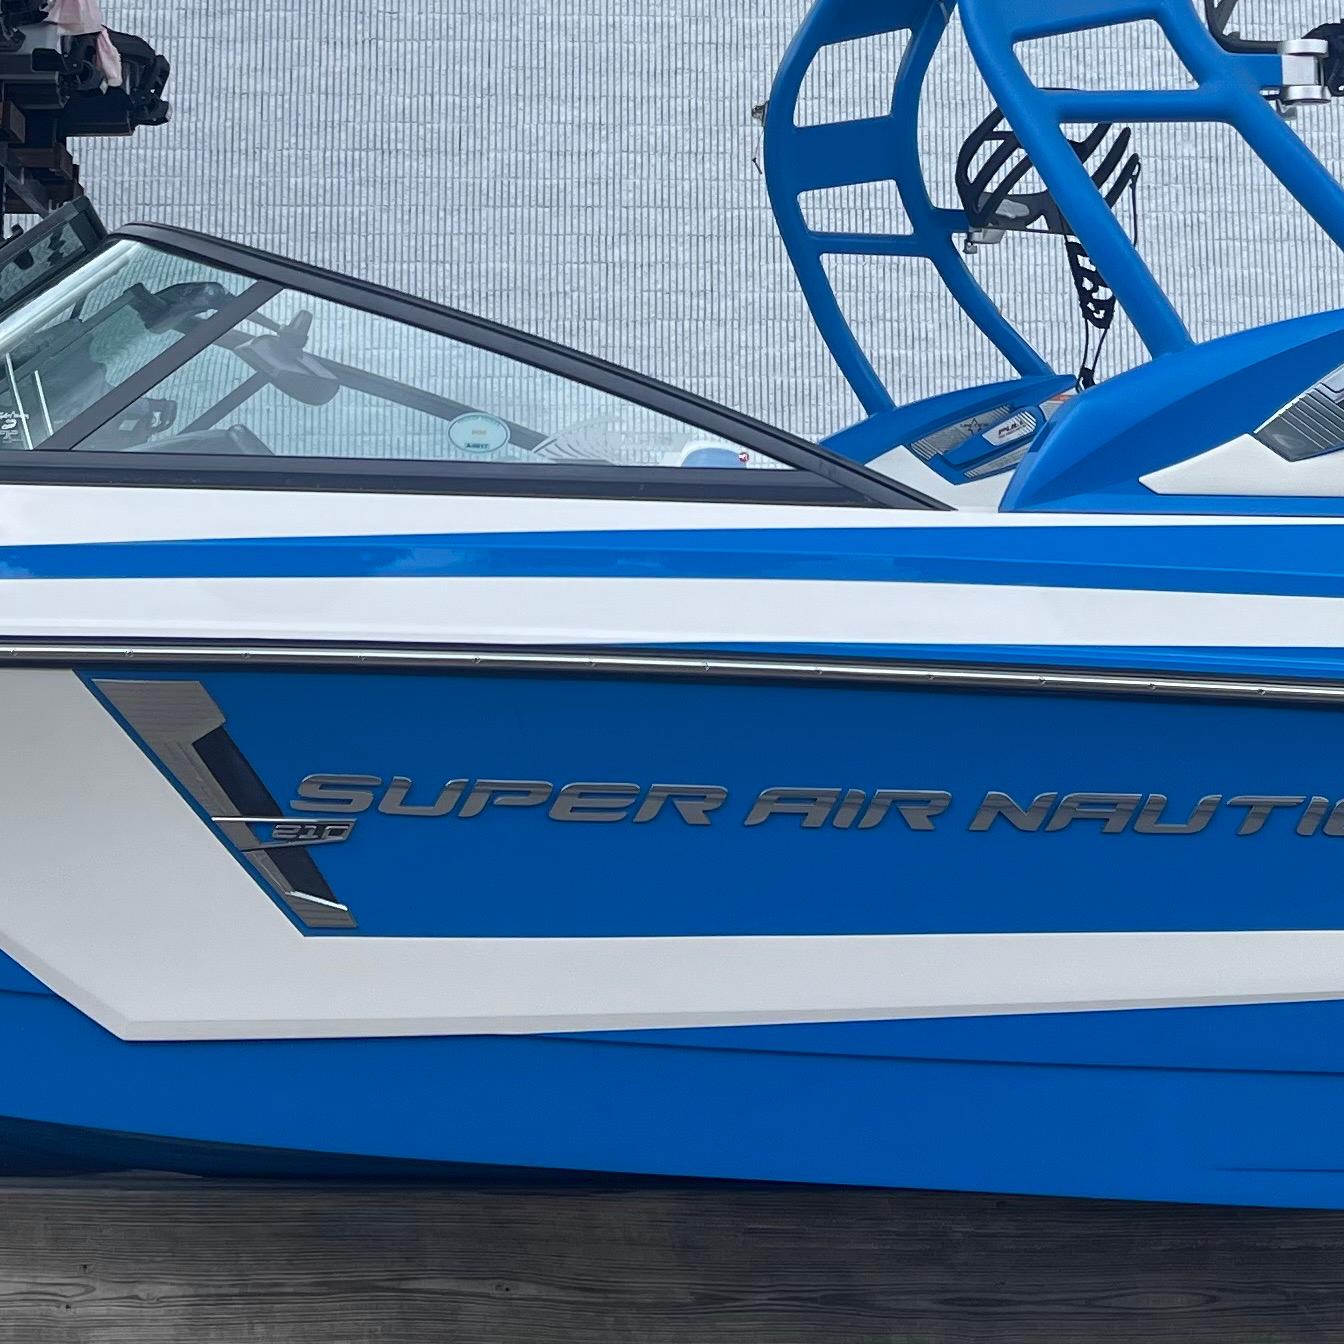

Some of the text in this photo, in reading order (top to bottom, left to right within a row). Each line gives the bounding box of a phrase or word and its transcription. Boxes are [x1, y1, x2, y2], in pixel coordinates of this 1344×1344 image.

[289, 773, 729, 826] SUPER
[744, 787, 954, 831] AIR
[272, 824, 353, 840] 210
